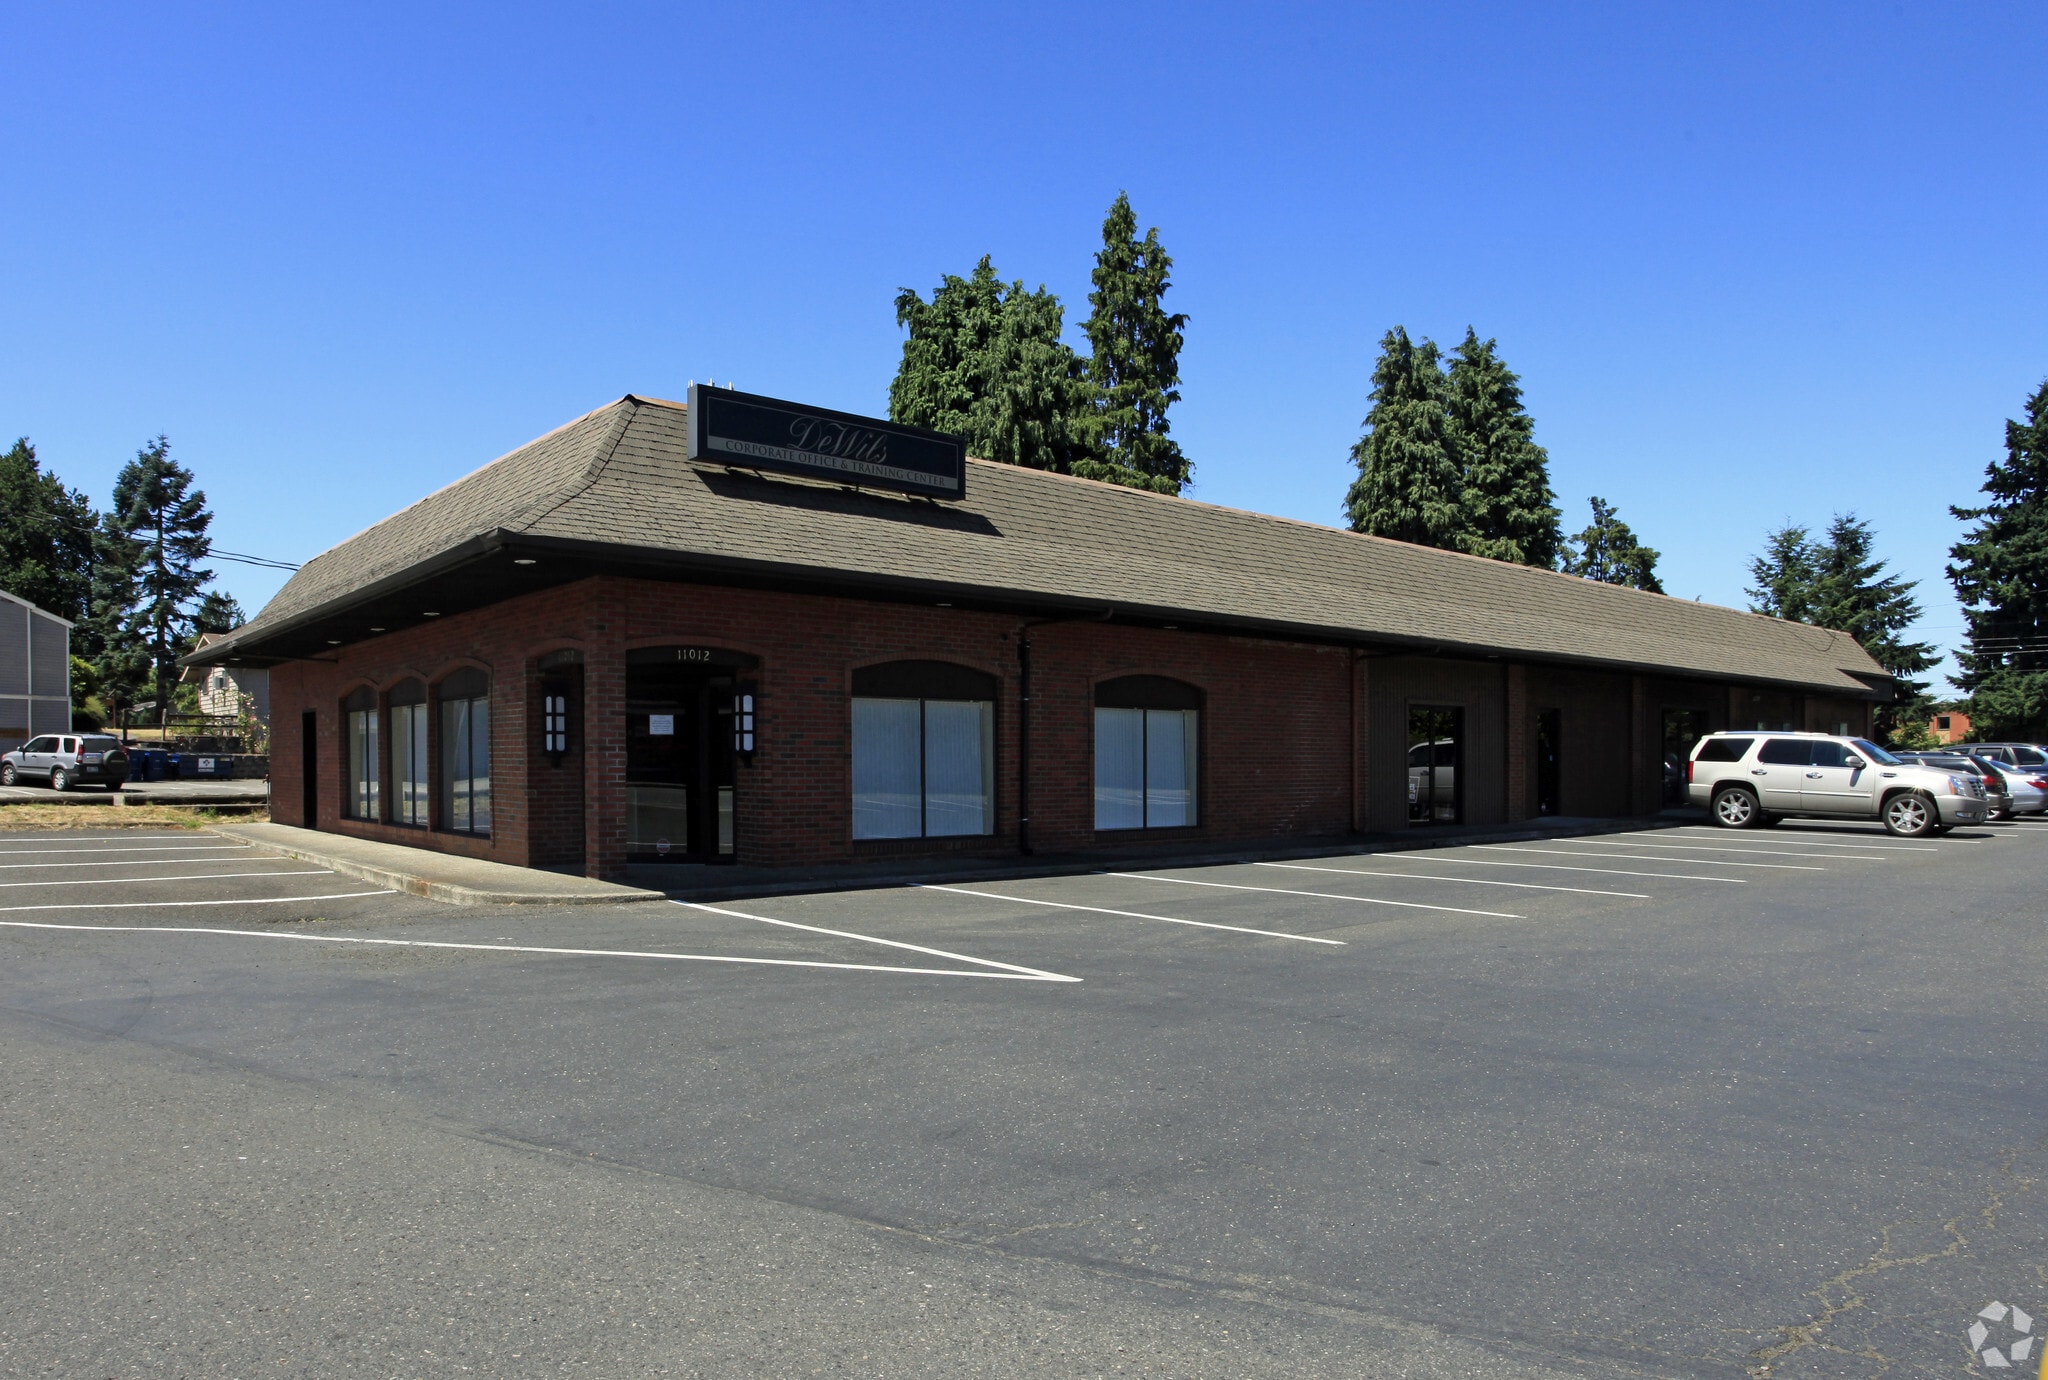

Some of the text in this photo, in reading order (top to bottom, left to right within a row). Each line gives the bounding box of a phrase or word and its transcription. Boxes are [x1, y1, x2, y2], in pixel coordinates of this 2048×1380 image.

[787, 416, 887, 463] DeWils
[726, 440, 945, 486] CORPORATE OFFICE & TRAINING CENTER
[678, 649, 710, 661] 11012
